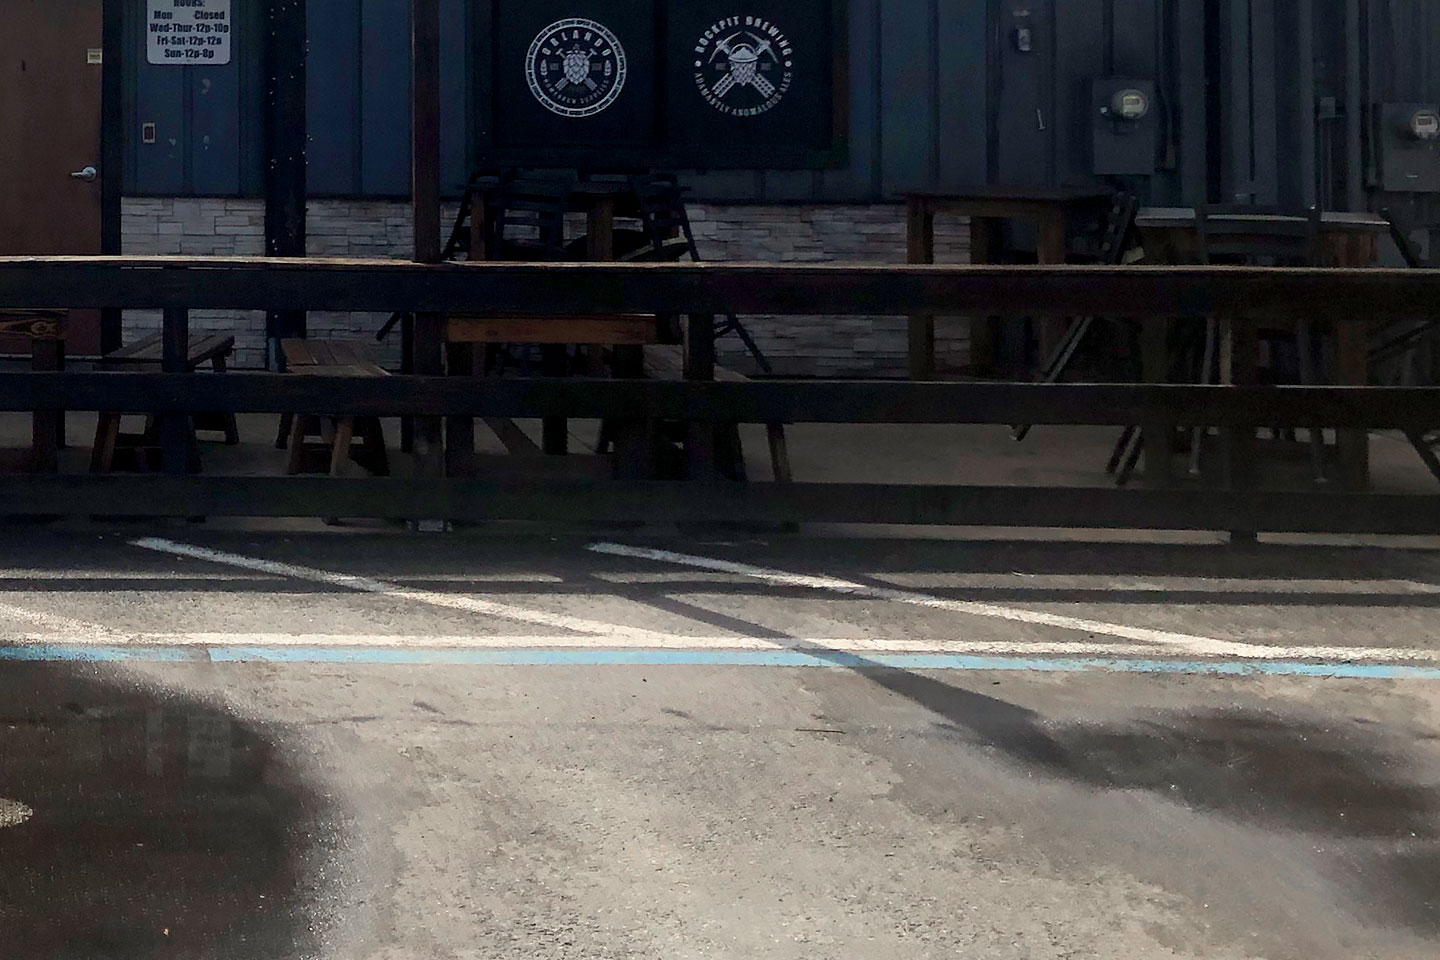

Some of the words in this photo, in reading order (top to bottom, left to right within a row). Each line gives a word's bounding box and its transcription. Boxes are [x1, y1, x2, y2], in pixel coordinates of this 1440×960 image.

[153, 10, 173, 20] Mon
[541, 29, 612, 57] ORLANDO
[694, 15, 740, 54] ROCKPIT
[745, 15, 793, 56] BREWING
